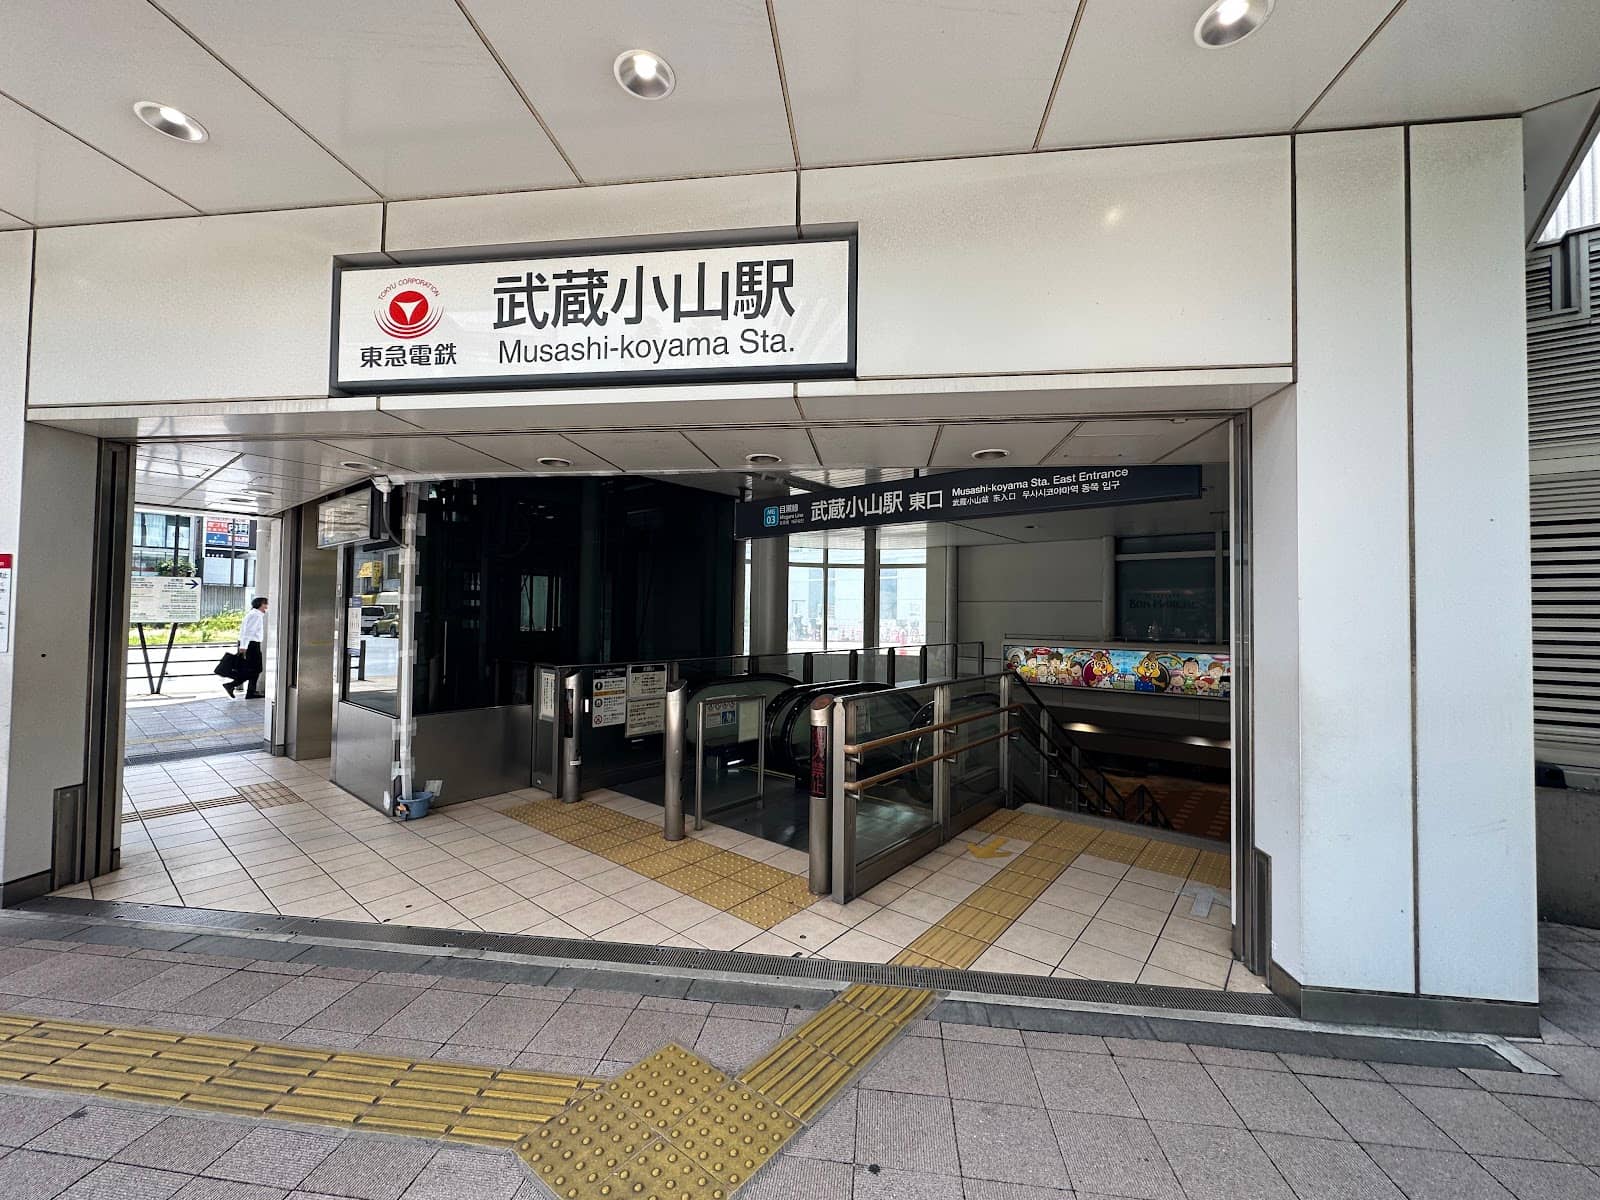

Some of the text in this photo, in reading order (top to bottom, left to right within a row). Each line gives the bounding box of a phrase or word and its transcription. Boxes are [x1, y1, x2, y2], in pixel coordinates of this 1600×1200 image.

[377, 277, 440, 300] TOKYU CORPORATION
[493, 258, 796, 330] 武蔵小山駅
[360, 342, 457, 368] 東急電鉄
[499, 328, 794, 364] Musashi-koyama Sta.
[952, 468, 1128, 497] Musashi-koyama Sta. East Entrance
[766, 515, 776, 524] 03
[810, 490, 943, 521] 武蔵小山駅 東口
